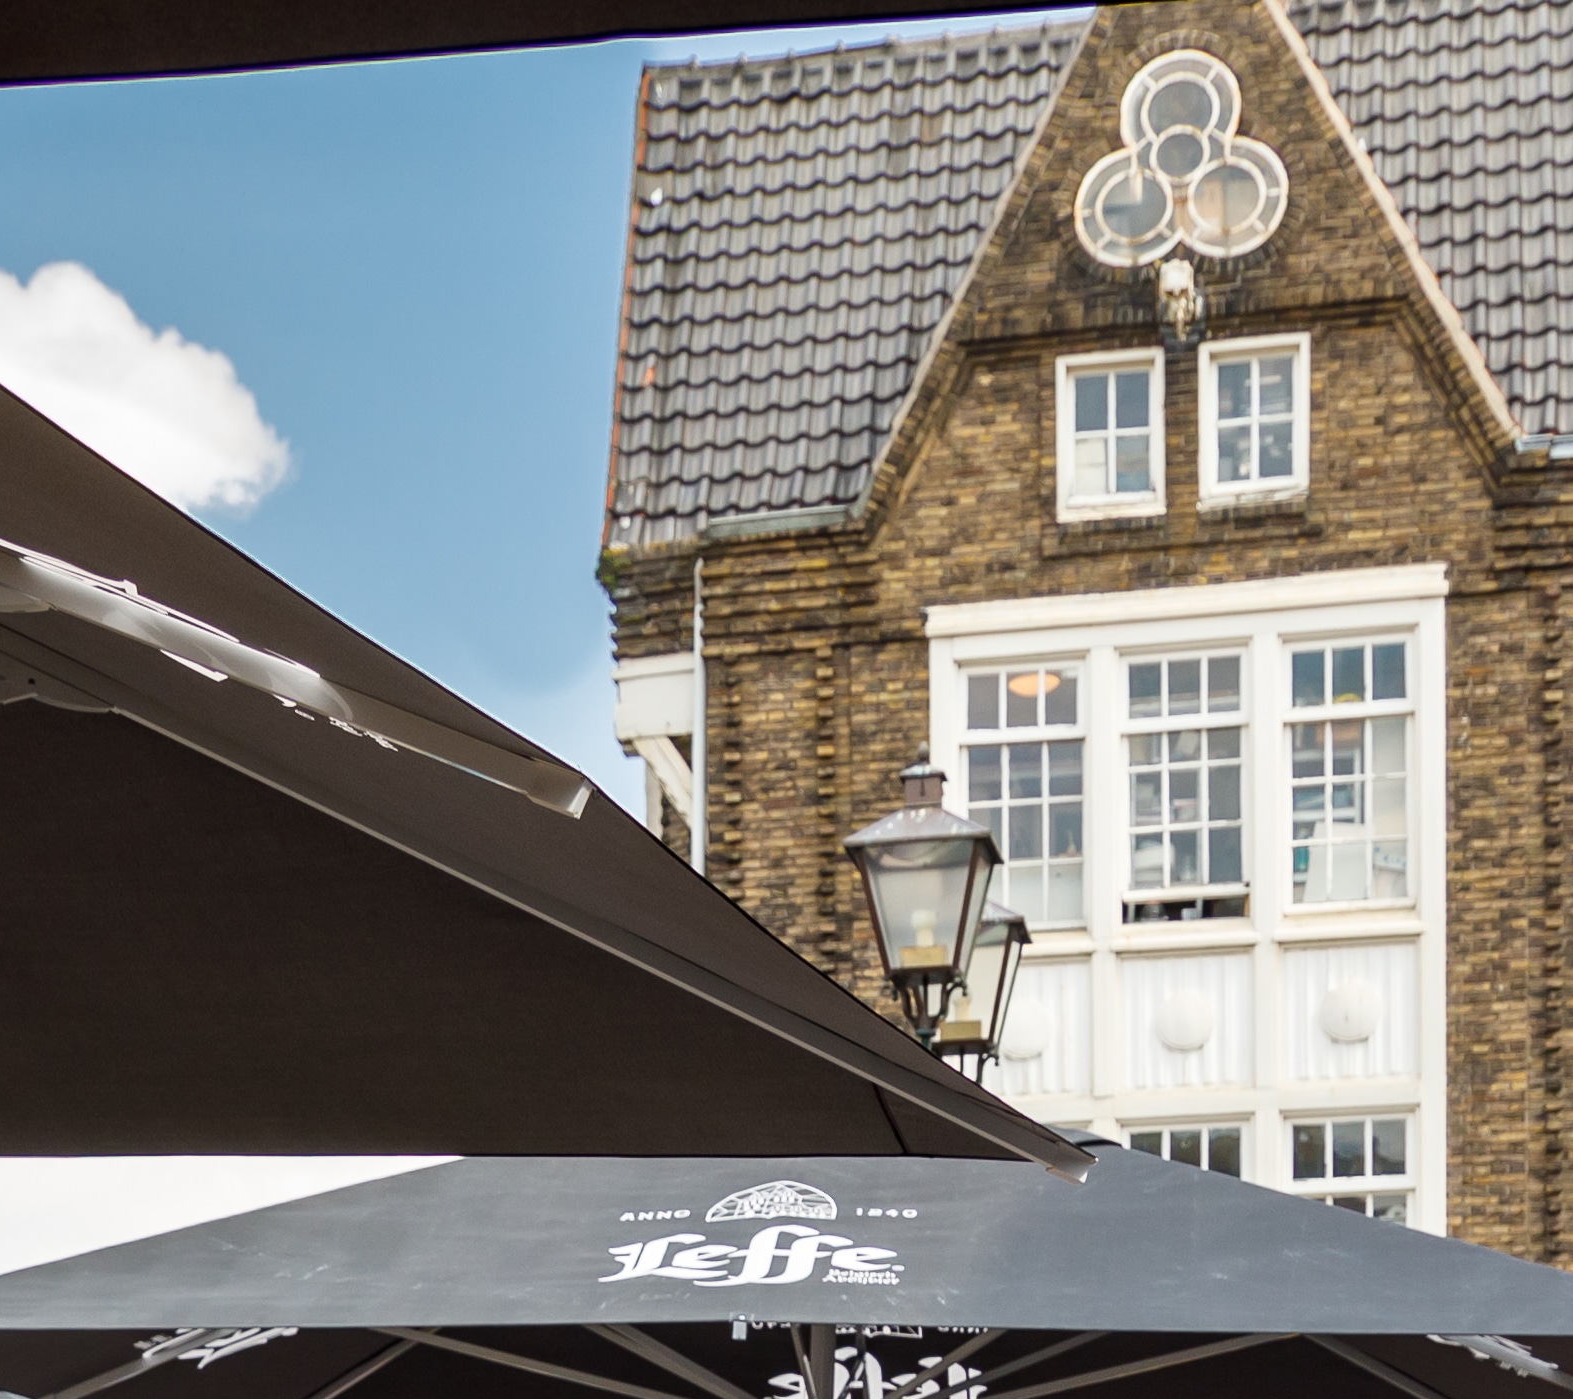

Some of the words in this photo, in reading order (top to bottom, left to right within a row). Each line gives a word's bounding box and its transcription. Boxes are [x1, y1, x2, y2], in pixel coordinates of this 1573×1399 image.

[619, 1208, 692, 1222] ANNO
[856, 1206, 919, 1219] 1240
[598, 1223, 898, 1288] Leffe
